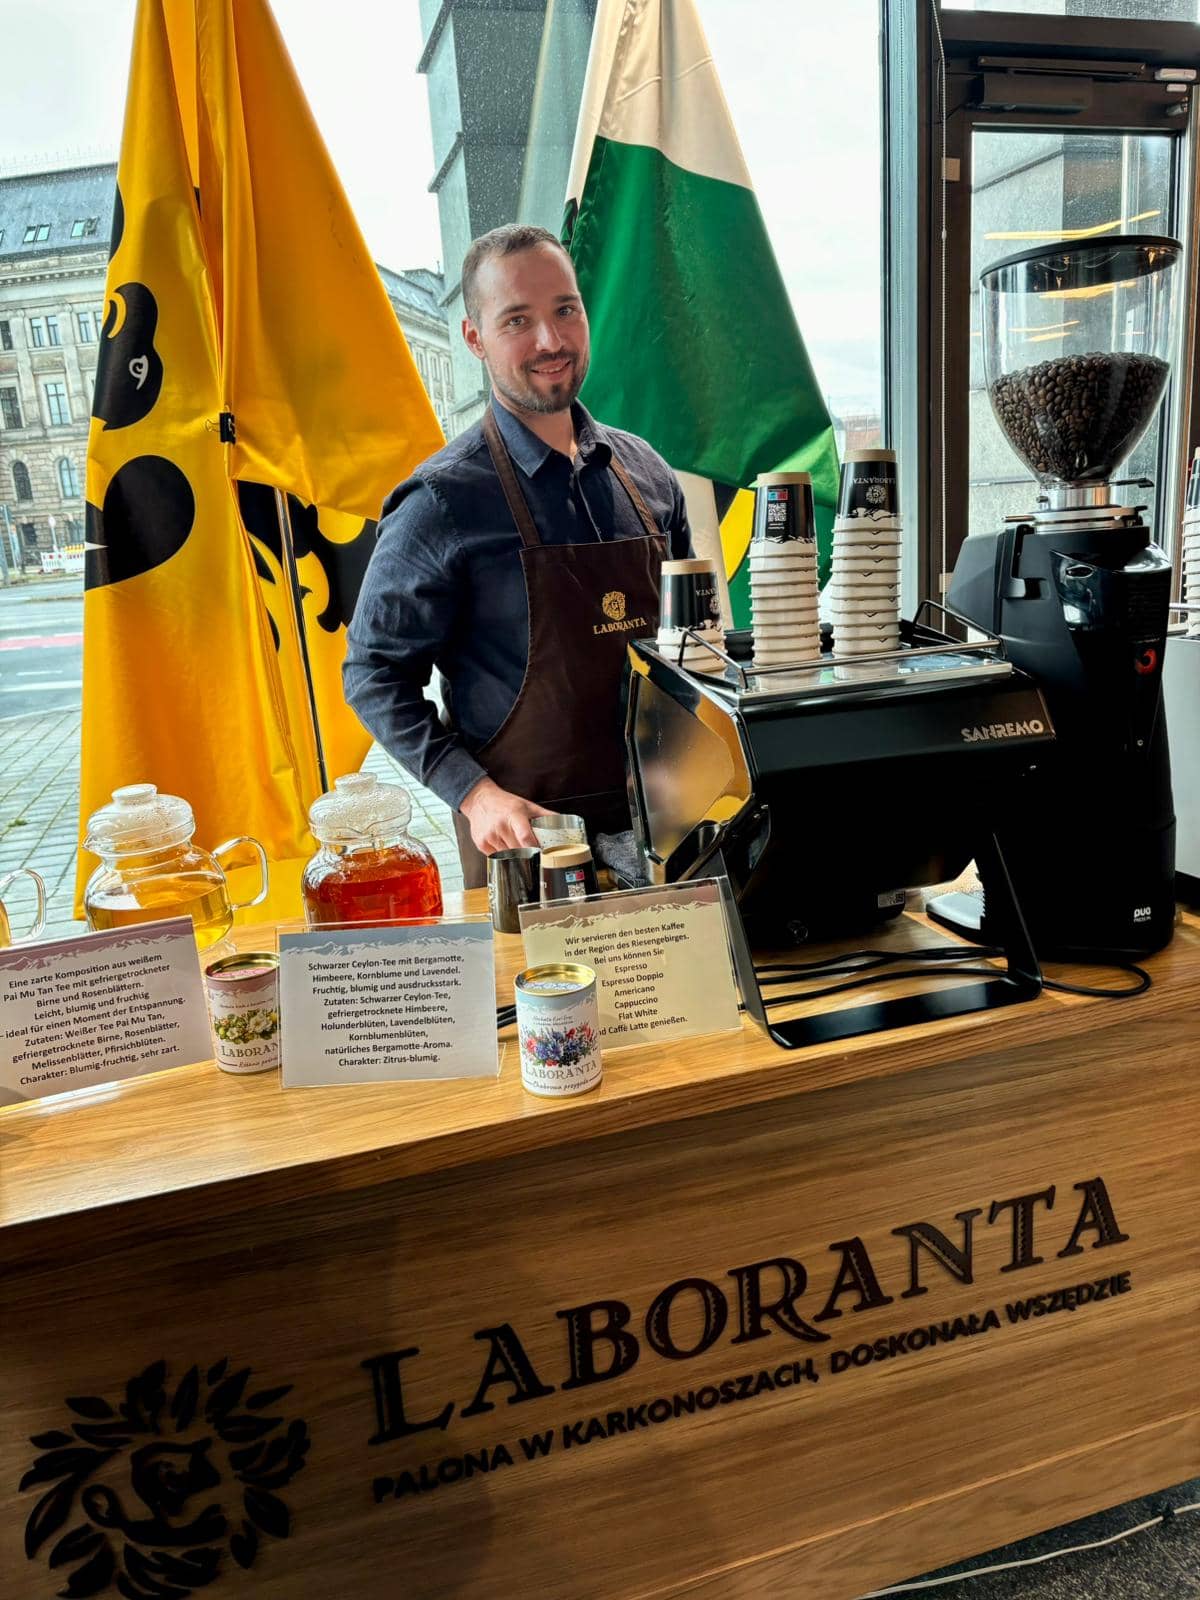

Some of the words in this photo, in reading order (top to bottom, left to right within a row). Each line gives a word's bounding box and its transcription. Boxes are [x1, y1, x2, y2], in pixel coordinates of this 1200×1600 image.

[593, 617, 647, 634] LABORANTA
[961, 719, 1044, 743] SANREMO
[565, 937, 579, 945] Wir
[582, 931, 617, 943] servieren
[619, 929, 632, 938] den
[635, 926, 660, 935] besten
[662, 922, 685, 931] Kaffee
[574, 947, 586, 956] der
[589, 943, 614, 955] Region
[617, 941, 630, 949] des
[632, 933, 689, 947] Riesengebirges.
[308, 961, 350, 971] Schwarzer
[352, 958, 396, 970] Ceylon-Tee
[399, 957, 412, 965] mit
[414, 954, 464, 966] Bergamotte,
[594, 957, 605, 965] Bei
[608, 954, 621, 962] uns
[624, 950, 651, 960] können
[653, 948, 664, 956] Sie
[9, 980, 28, 989] Eine
[31, 975, 52, 985] zarte
[55, 964, 110, 980] Komposition
[112, 962, 127, 970] aus
[129, 954, 162, 966] weißem
[313, 973, 355, 982] Himbeere,
[358, 969, 402, 979] Kornblume
[404, 968, 420, 977] und
[422, 967, 460, 976] Lavendel.
[615, 962, 647, 974] Espresso
[4, 993, 18, 1001] Pai
[20, 990, 35, 999] Mu
[37, 986, 53, 996] Tan
[56, 984, 70, 992] Tee
[73, 980, 87, 989] mit
[90, 964, 170, 986] gefriergetrockneter
[313, 985, 348, 995] Fruchtig,
[351, 982, 378, 993] blumig
[381, 982, 396, 990] und
[398, 979, 461, 988] ausdrucksstark.
[602, 976, 635, 987] Espresso
[637, 972, 663, 984] Doppio
[37, 997, 60, 1007] Birne
[63, 994, 79, 1002] und
[82, 983, 144, 998] Rosenblättern.
[324, 997, 358, 1006] Zutaten:
[360, 994, 402, 1004] Schwarzer
[404, 992, 451, 1003] Ceylon-Tee,
[614, 985, 655, 997] Americano
[34, 1010, 64, 1020] Leicht,
[66, 1001, 96, 1014] blumig
[98, 998, 114, 1007] und
[117, 991, 150, 1005] fruchtig
[615, 996, 658, 1010] Cappuccino
[6, 1028, 28, 1038] ideal
[30, 1024, 43, 1033] für
[46, 1019, 71, 1029] einen
[73, 1012, 110, 1025] Moment
[113, 1007, 127, 1016] der
[129, 998, 186, 1013] Entspannung.
[328, 1007, 403, 1019] gefriergetrocknete
[405, 1005, 448, 1014] Himbeere,
[619, 1011, 633, 1021] Flat
[635, 1008, 658, 1018] White
[25, 1035, 63, 1046] Zutaten:
[65, 1027, 97, 1039] Weißer
[100, 1023, 114, 1031] Tee
[116, 1019, 129, 1028] Pai
[131, 1016, 146, 1024] Mu
[148, 1013, 165, 1022] Tan,
[322, 1021, 388, 1031] Holunderblüten,
[390, 1016, 455, 1027] Lavendelblüten,
[630, 1022, 648, 1030] Latte
[650, 1016, 688, 1028] genießen.
[12, 1039, 95, 1063] gefriergetrocknete
[97, 1033, 122, 1045] Birne,
[125, 1022, 180, 1038] Rosenblätter,
[350, 1030, 428, 1041] Kornblumenblüten,
[221, 1042, 278, 1057] LABORAN
[325, 1045, 370, 1054] natürliches
[373, 1041, 452, 1054] Bergamotte-Aroma.
[20, 1069, 67, 1085] Charakter:
[141, 1049, 159, 1058] sehr
[161, 1044, 180, 1055] zart.
[339, 1057, 381, 1067] Charakter:
[383, 1054, 440, 1064] Zitrus-blumig.
[525, 1060, 597, 1080] LABORANTA
[361, 1176, 1130, 1446] LABORANTA
[372, 1444, 513, 1503] PALONA
[519, 1430, 553, 1459] W
[563, 1358, 820, 1448] KARKONOSZACH,
[830, 1309, 1001, 1374] DOSKONAŁA
[1006, 1270, 1132, 1324] WSZĘDZIE
